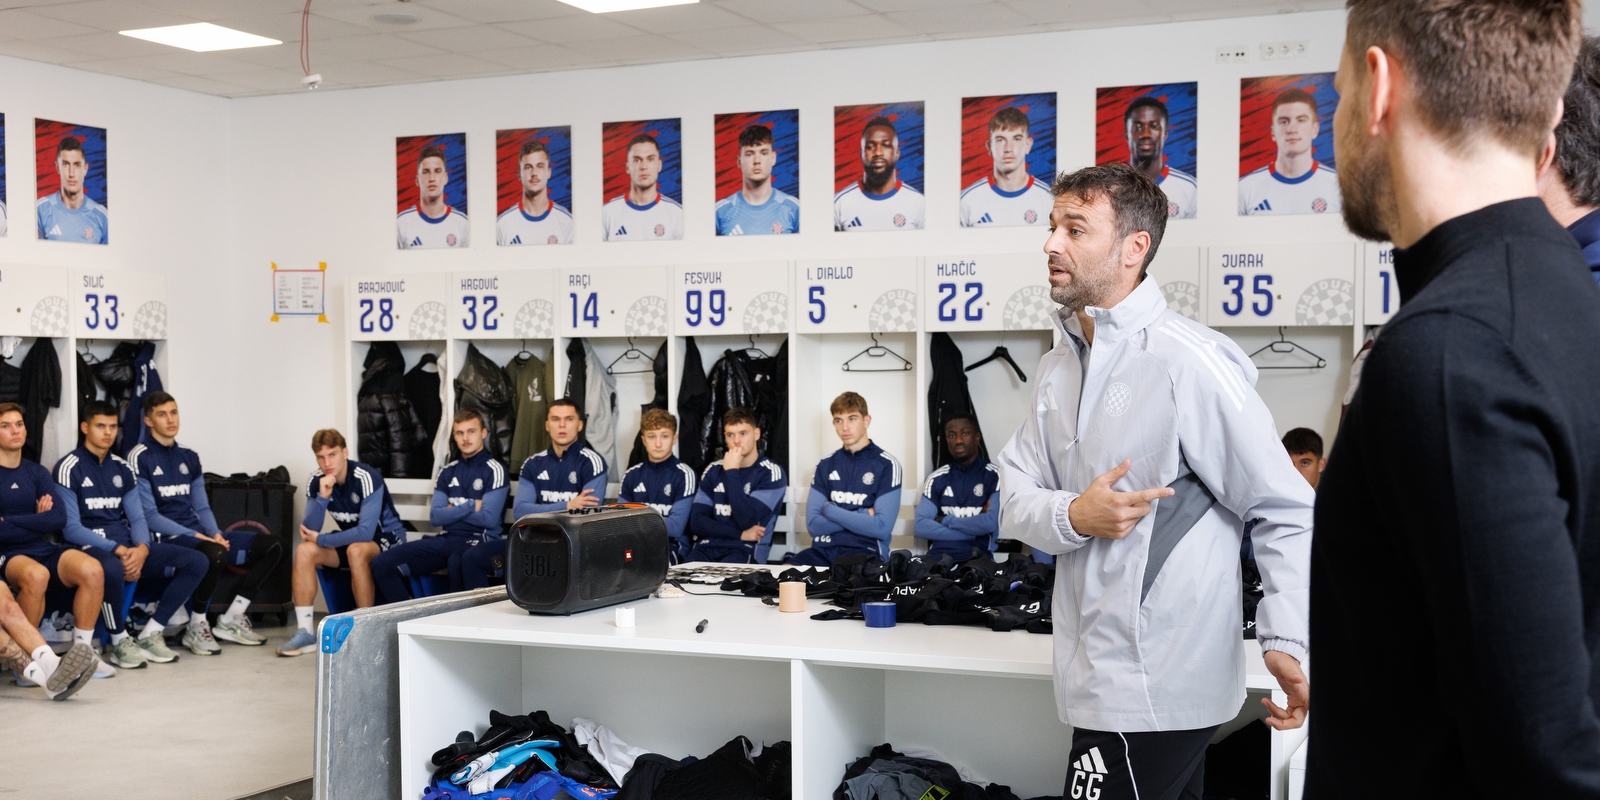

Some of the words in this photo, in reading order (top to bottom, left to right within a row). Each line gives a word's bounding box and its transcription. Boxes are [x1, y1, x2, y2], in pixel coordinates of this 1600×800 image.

[817, 266, 853, 280] DIALLO
[937, 260, 976, 277] MLAČIĆ
[1222, 254, 1264, 268] JURAK
[83, 274, 104, 289] SILIĆ
[358, 279, 405, 294] BRAJKOVIĆ
[461, 276, 499, 291] HRGOVIĆ
[684, 271, 722, 285] FESYUK
[569, 292, 600, 329] 14
[626, 296, 666, 326] HAJDUK
[685, 289, 726, 327] 99
[743, 293, 787, 324] HAJDUK
[808, 285, 826, 324] 5
[870, 289, 916, 322] HAJDUK
[938, 282, 983, 322] 22
[1222, 274, 1273, 317] 35
[1297, 279, 1353, 314] HAJDUK
[85, 293, 119, 331] 33
[359, 298, 394, 333] 28
[462, 295, 498, 331] 32
[524, 554, 557, 578] JBL
[1071, 770, 1104, 800] GG
